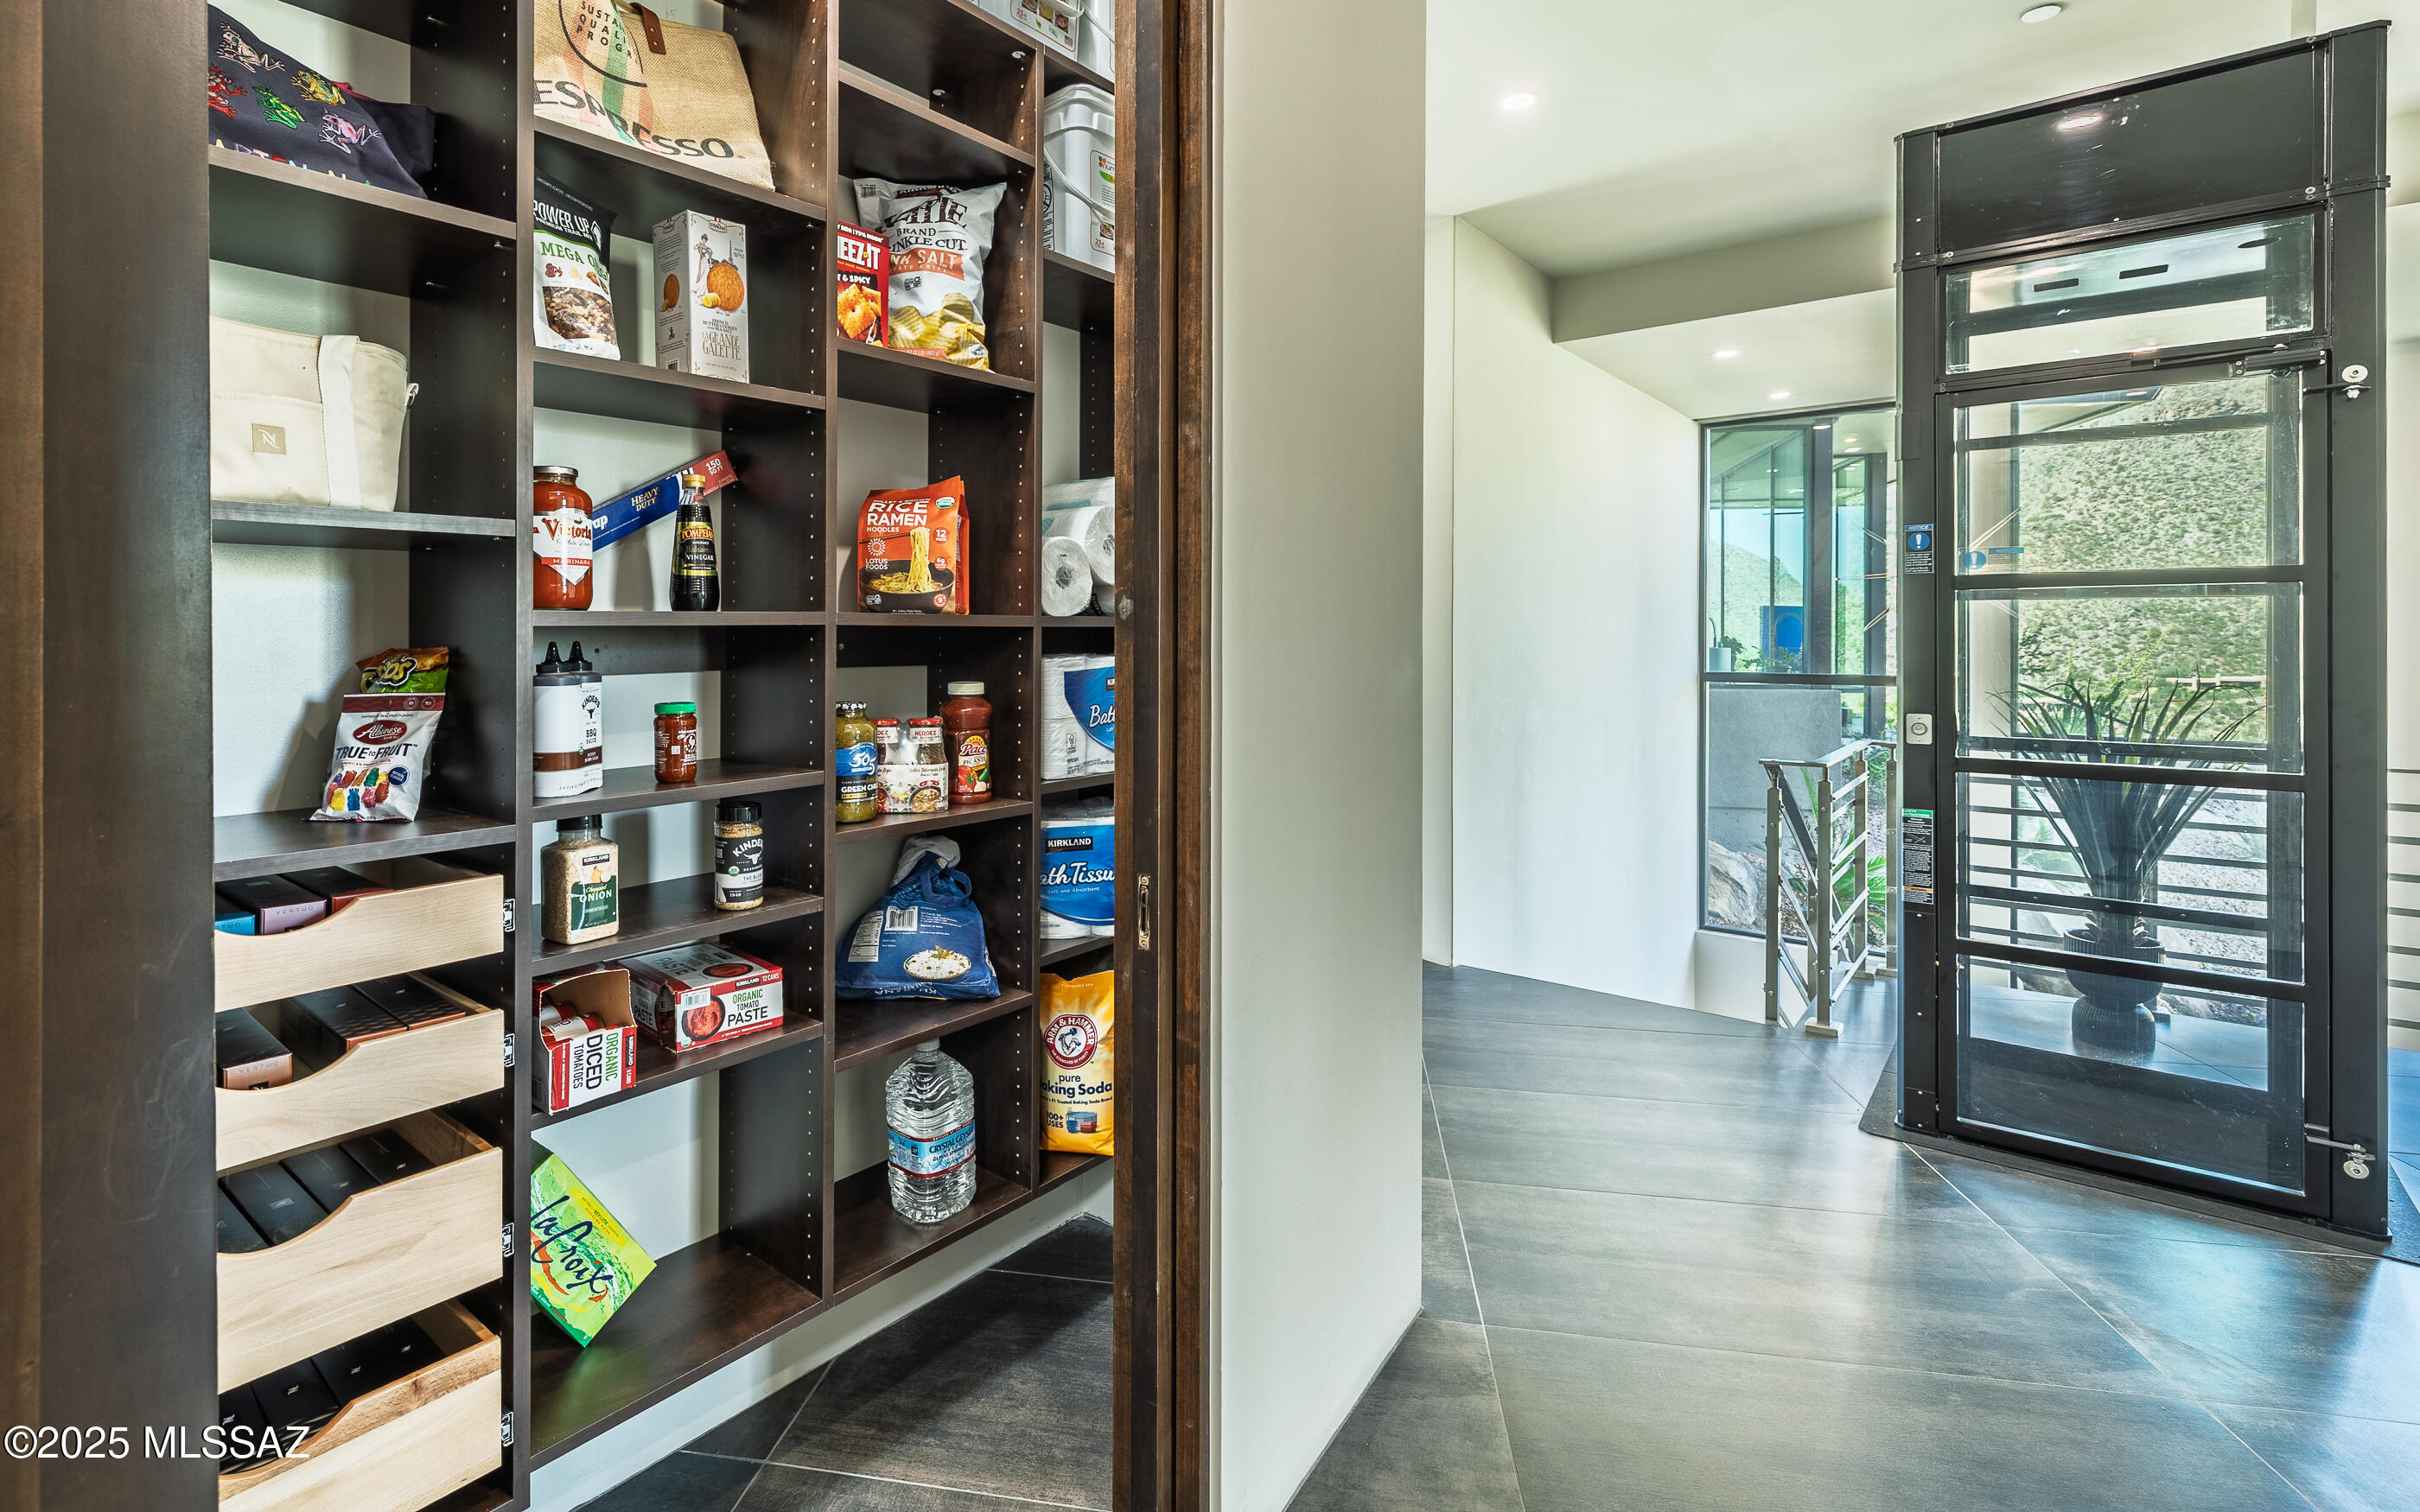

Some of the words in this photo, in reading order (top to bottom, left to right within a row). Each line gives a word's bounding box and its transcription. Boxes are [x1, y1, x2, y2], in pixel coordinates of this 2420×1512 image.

[533, 200, 574, 231] POWER
[574, 215, 590, 235] UP
[564, 226, 583, 238] TRAIL
[896, 227, 937, 238] BRAND
[889, 236, 933, 252] INKLE
[935, 238, 966, 251] CUT
[540, 241, 585, 264] MEGA
[917, 250, 958, 270] SALT
[919, 264, 948, 274] CHIPS
[850, 275, 871, 285] SPICY
[709, 331, 741, 348] GRANDE
[702, 339, 742, 361] GALETTE
[705, 458, 722, 471] 150
[630, 486, 659, 507] HEAVY
[635, 498, 657, 511] DUTY
[868, 500, 930, 514] RICE
[867, 512, 927, 526] RAMEN
[935, 529, 947, 537] 12
[1089, 704, 1115, 728] Bat
[585, 727, 597, 739] BBQ
[335, 746, 370, 761] TRUE
[373, 742, 413, 760] FRUIT
[848, 751, 876, 776] 505
[841, 785, 867, 793] GREEN
[1048, 837, 1092, 848] KIRKLAND
[583, 854, 609, 863] KIRKLAND
[1041, 862, 1072, 886] ath
[1069, 861, 1115, 886] Tissu
[579, 889, 612, 903] ONION
[276, 905, 314, 915] VERTUO
[736, 977, 761, 987] KIRKLAND
[732, 988, 763, 1004] ORGANIC
[736, 1000, 760, 1012] TOMATO
[634, 1005, 653, 1028] PASTE
[728, 1005, 768, 1027] PASTE
[1047, 1025, 1060, 1045] ARM
[1059, 1018, 1067, 1026] &
[1067, 1017, 1095, 1045] HAMMER
[585, 1033, 603, 1090] DICED
[605, 1032, 619, 1082] ORGANIC
[1055, 1055, 1074, 1064] STANDARD
[239, 1061, 278, 1073] VERTUO
[573, 1043, 584, 1090] TOMATOES
[1059, 1074, 1081, 1084] pure
[1078, 1080, 1112, 1096] Soda
[1046, 1110, 1064, 1121] 100+
[1047, 1118, 1064, 1128] USES
[928, 1138, 956, 1153] CRYSTAL
[955, 1125, 975, 1143] GEYSER
